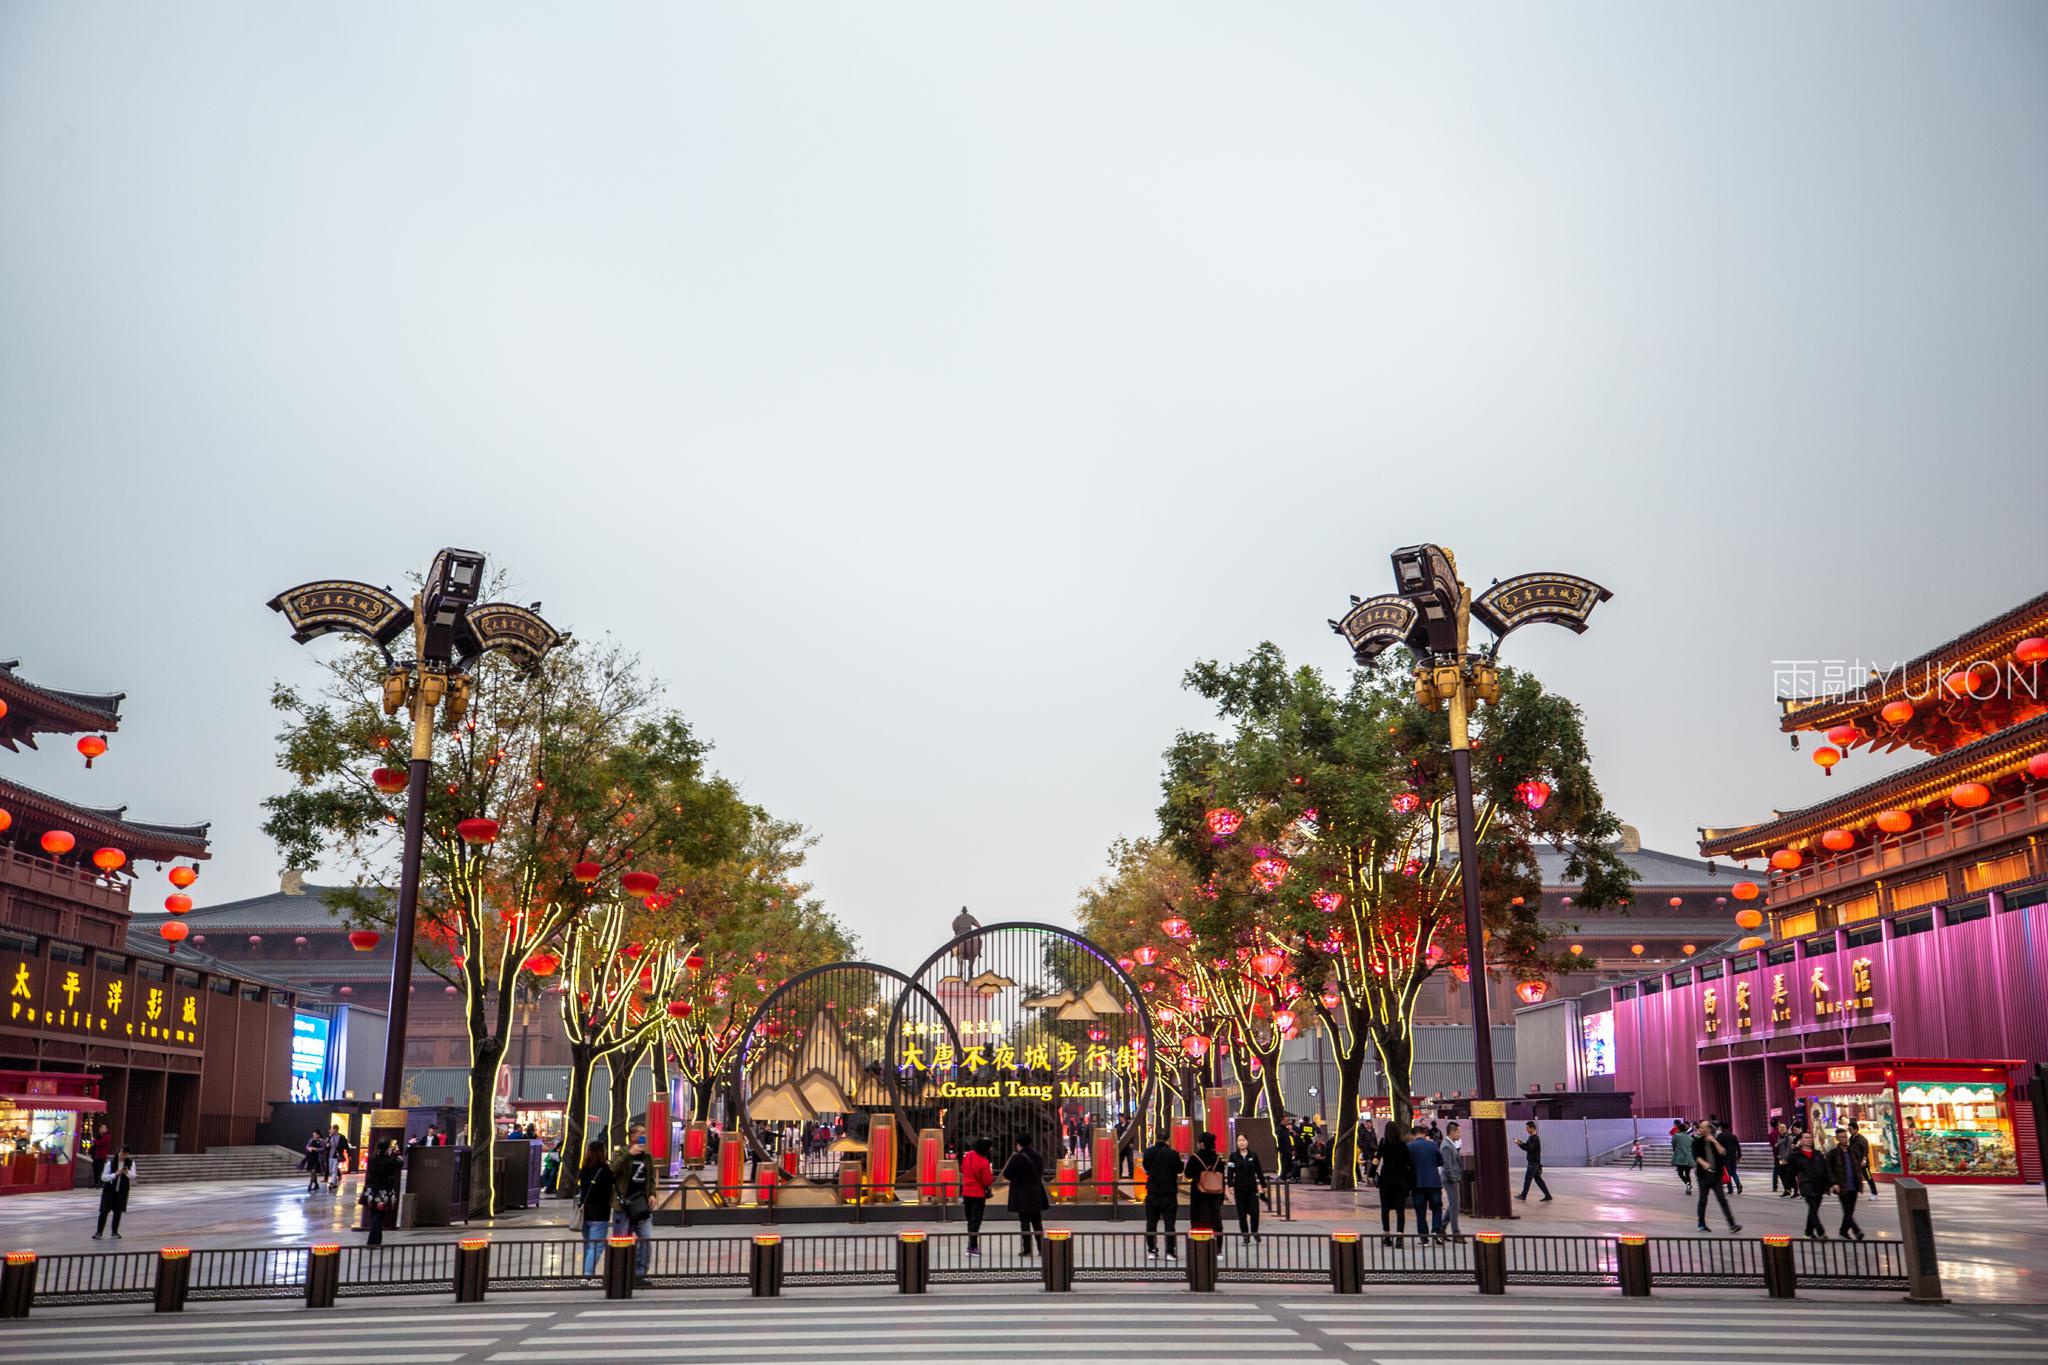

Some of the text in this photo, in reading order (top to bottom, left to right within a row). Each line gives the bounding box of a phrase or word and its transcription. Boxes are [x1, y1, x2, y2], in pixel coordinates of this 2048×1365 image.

[10, 961, 197, 1026] 太平洋影城
[1771, 1008, 1791, 1023] Art
[1815, 996, 1874, 1016] Museum
[11, 1001, 195, 1043] Pacific cinema
[901, 1041, 1139, 1073] 大唐不夜城步行街
[940, 1080, 1103, 1101] Grand Tang Mall
